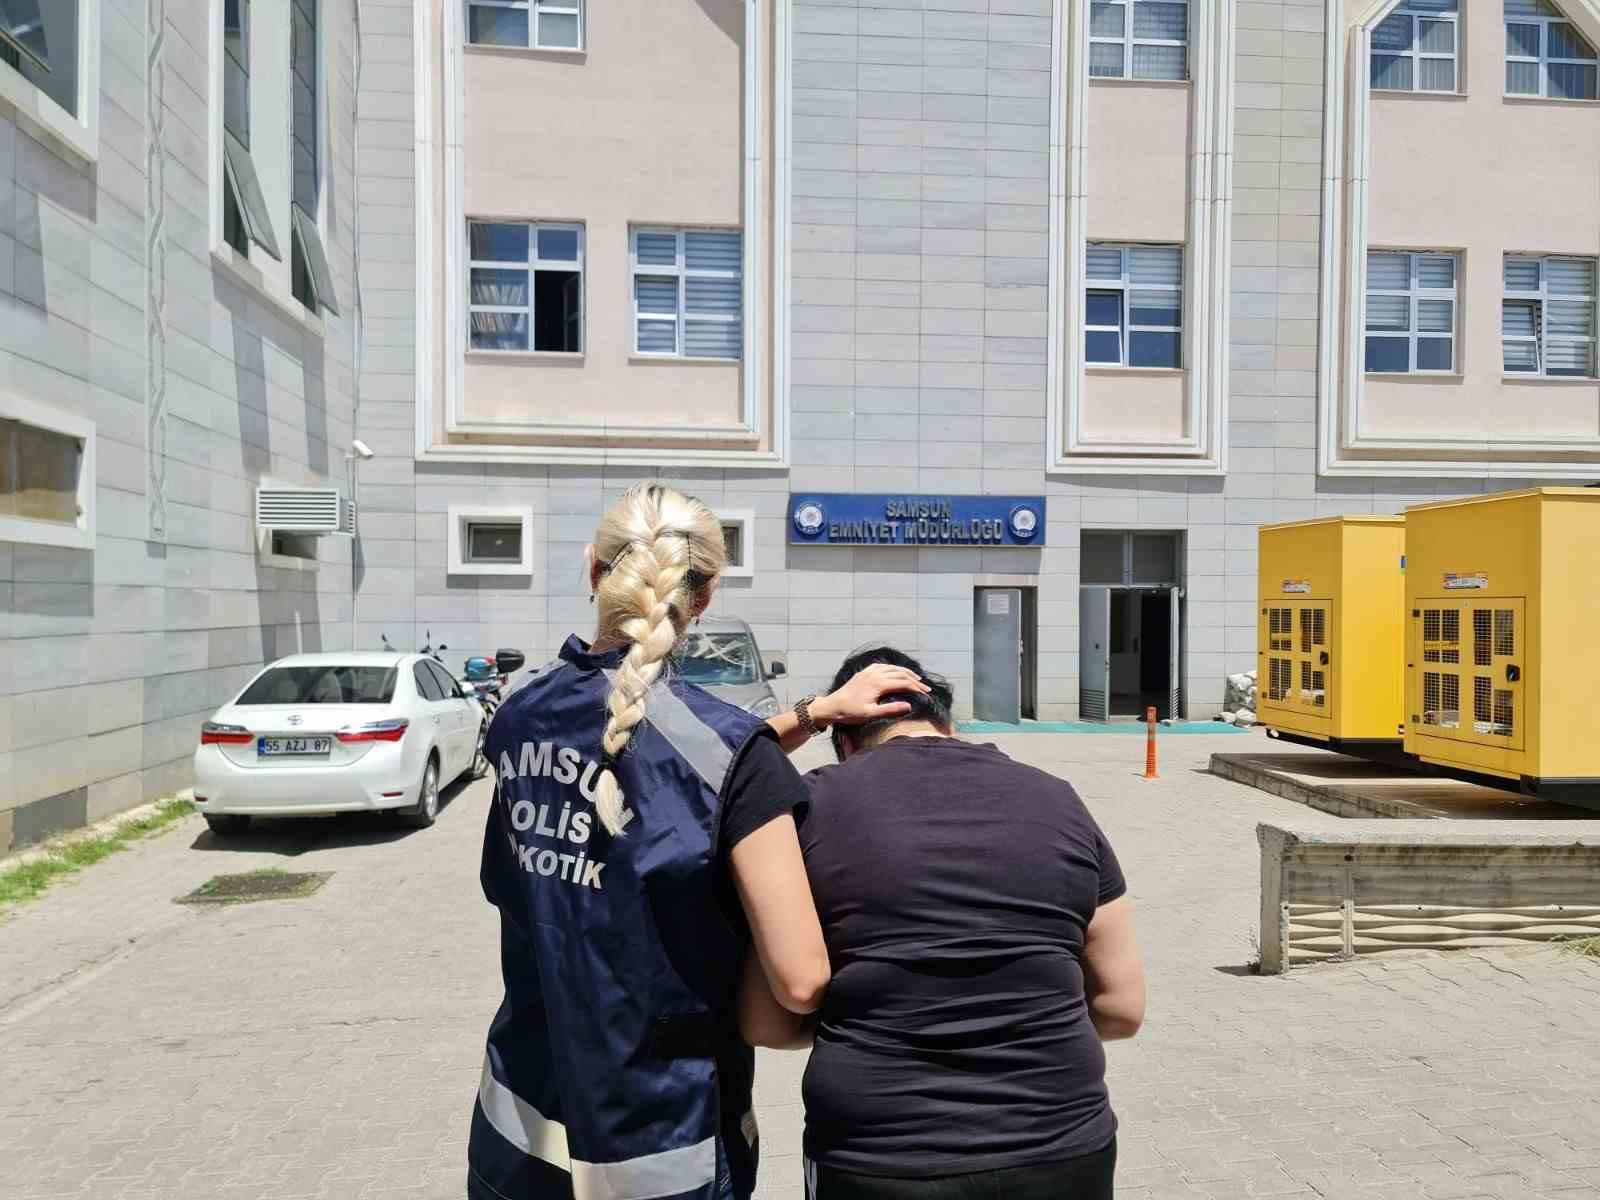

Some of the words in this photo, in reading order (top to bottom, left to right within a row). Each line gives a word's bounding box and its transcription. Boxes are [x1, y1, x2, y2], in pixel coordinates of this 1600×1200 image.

[887, 499, 951, 518] SAMSUN
[265, 740, 280, 751] 55
[285, 740, 307, 751] AZJ
[497, 742, 634, 830] AMSU
[507, 799, 592, 844] OLİS
[508, 833, 606, 889] KOTİK
